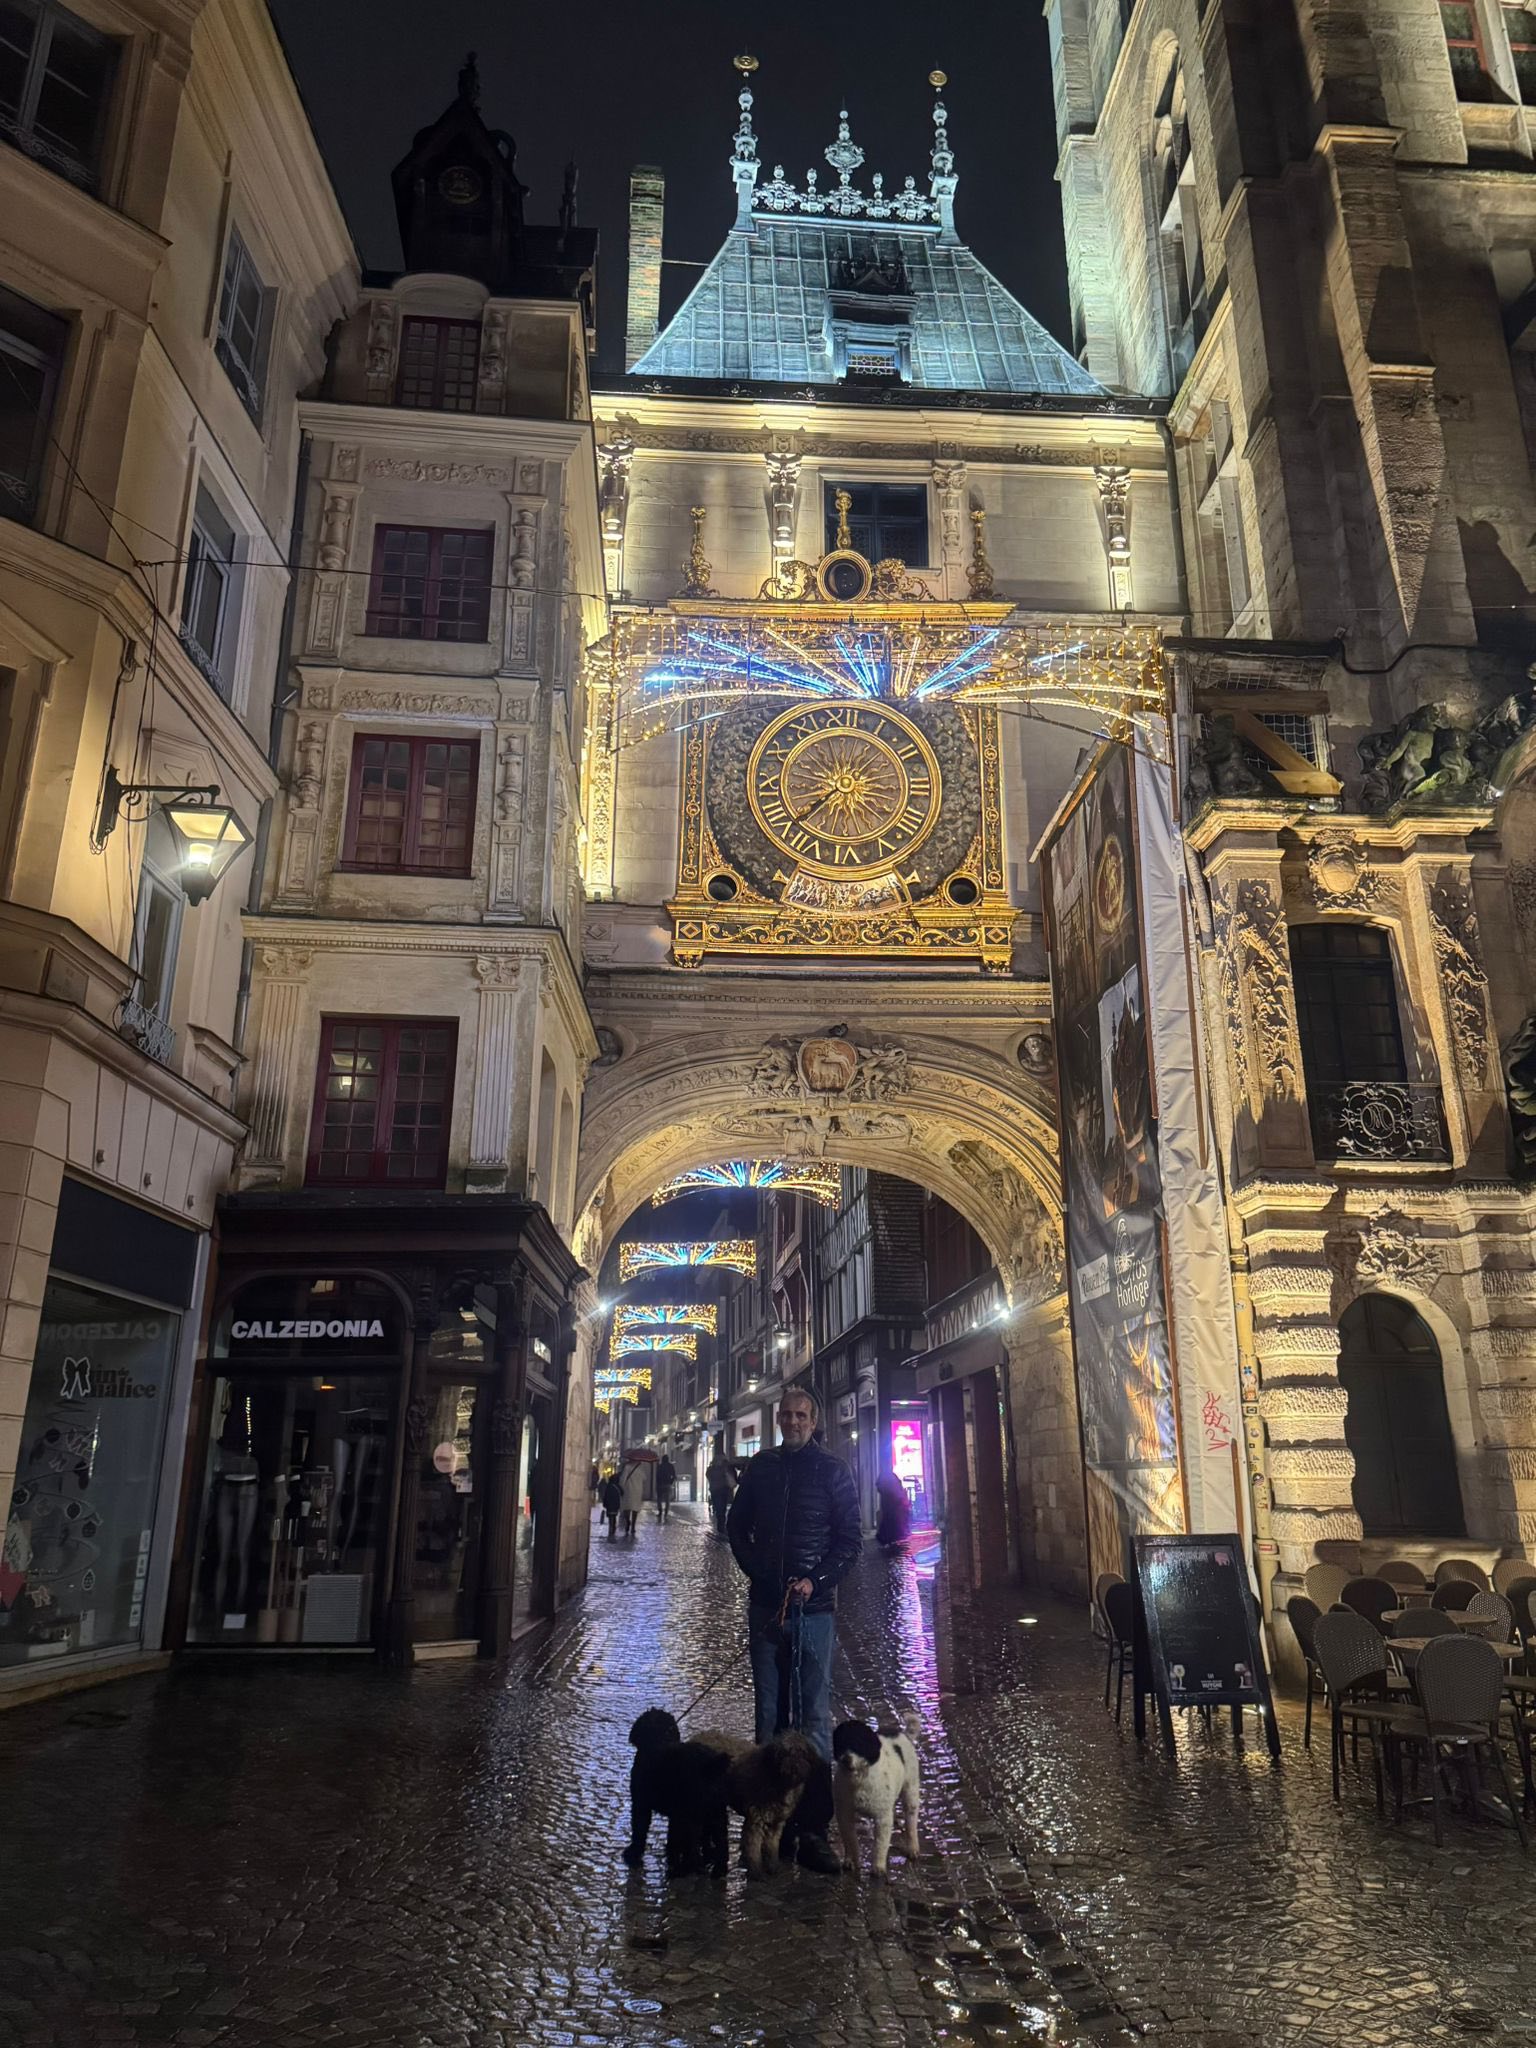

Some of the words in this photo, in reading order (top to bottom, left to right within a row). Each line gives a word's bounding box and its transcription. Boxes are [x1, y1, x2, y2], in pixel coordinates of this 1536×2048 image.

[789, 714, 819, 740] XI
[825, 709, 858, 727] XII
[874, 719, 886, 735] I
[897, 743, 919, 760] II
[910, 777, 930, 796] III
[1116, 1278, 1149, 1308] Horloge
[231, 1319, 385, 1339] CALZEDONIA
